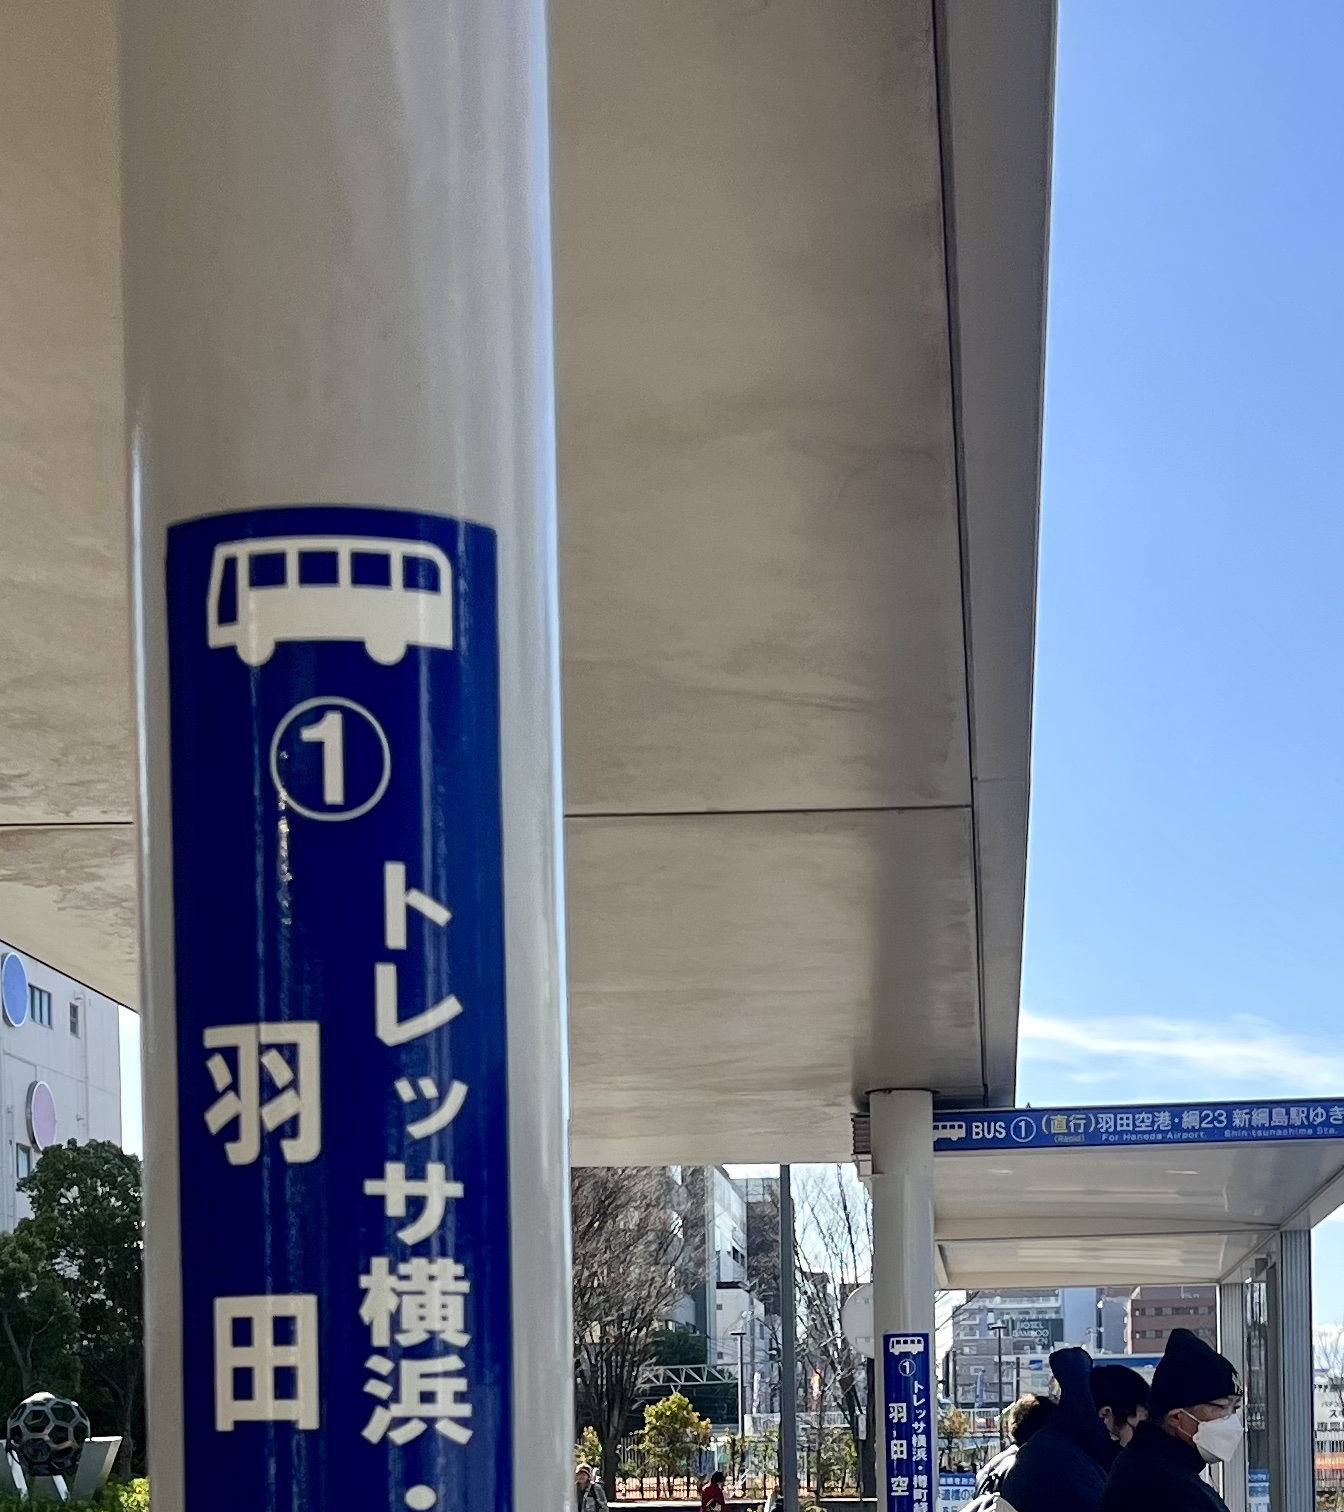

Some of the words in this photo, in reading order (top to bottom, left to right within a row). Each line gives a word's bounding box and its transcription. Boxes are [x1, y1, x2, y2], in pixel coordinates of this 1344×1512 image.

[971, 1121, 1007, 1140] BUS
[1101, 1134, 1120, 1142] For
[1122, 1132, 1164, 1141] Haneda
